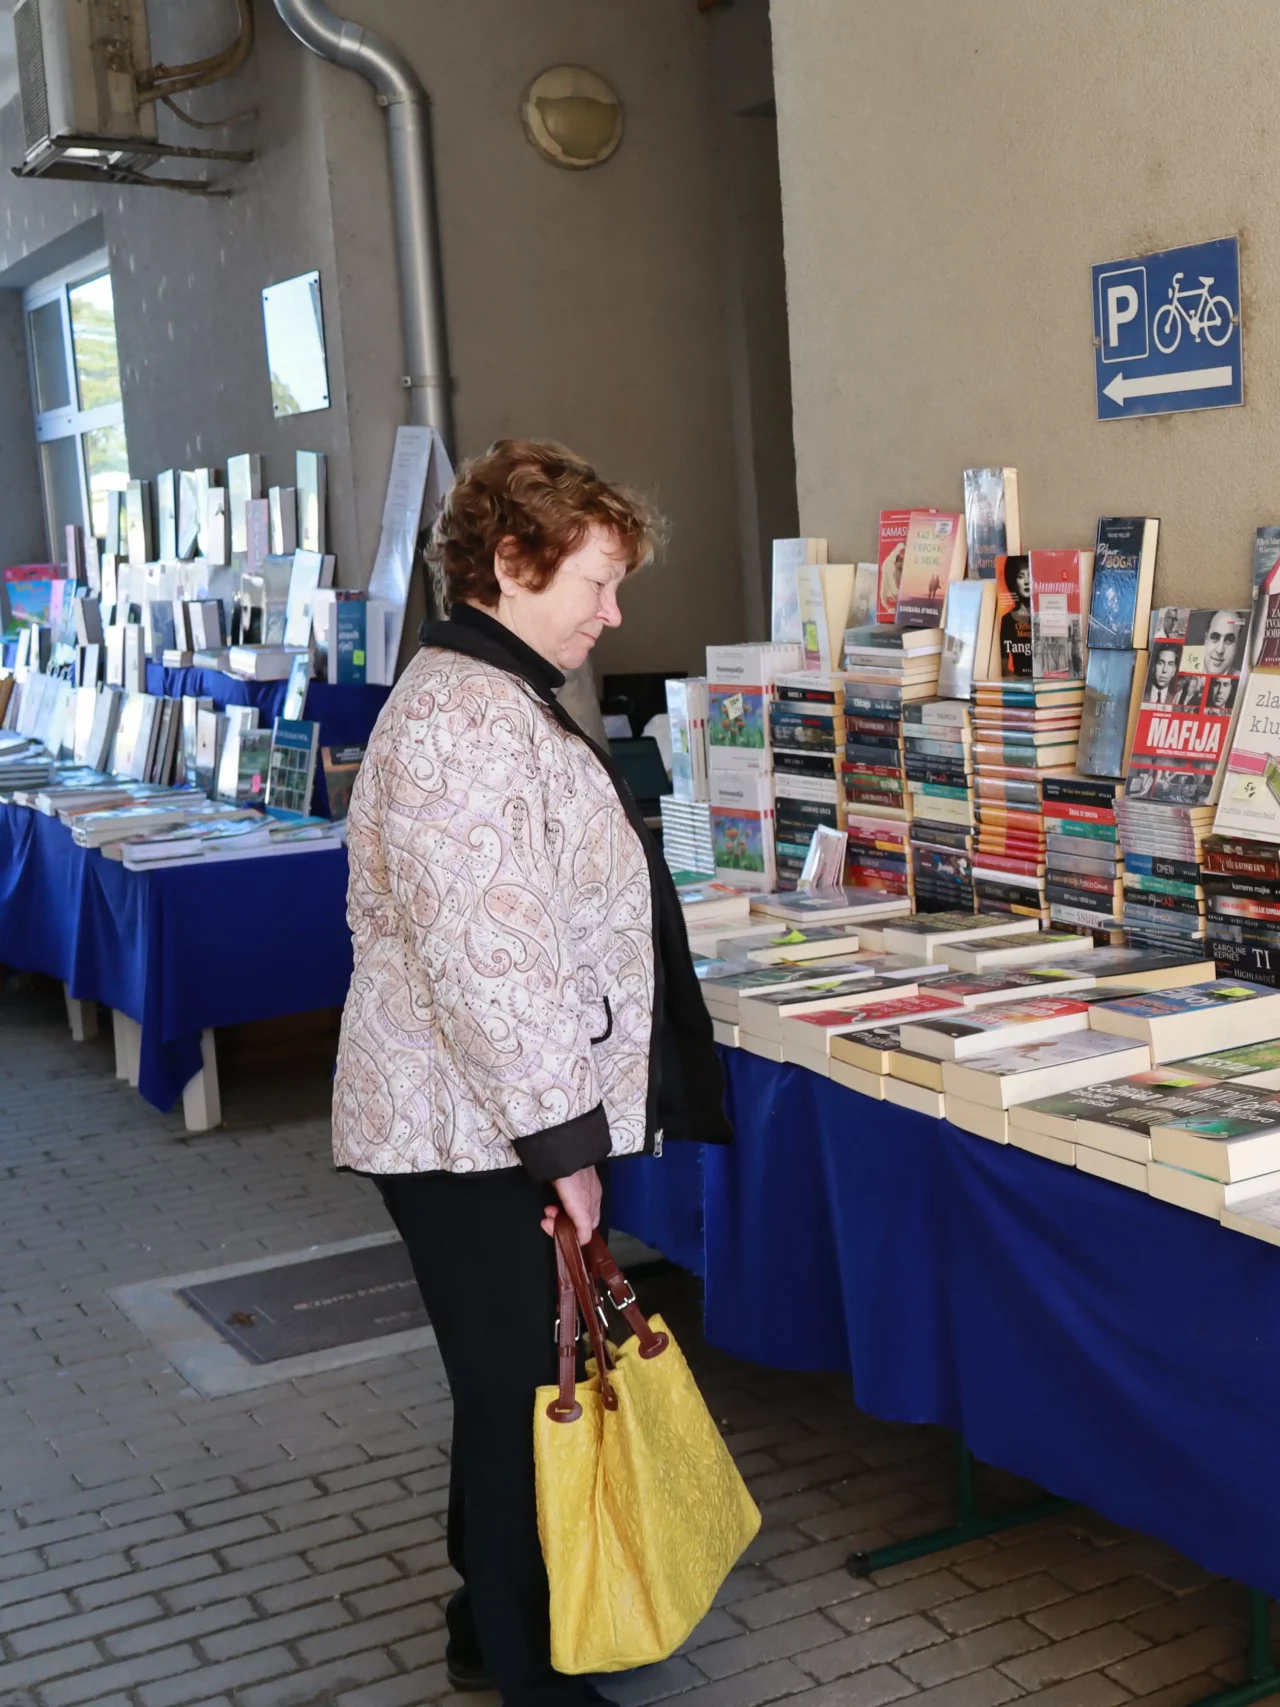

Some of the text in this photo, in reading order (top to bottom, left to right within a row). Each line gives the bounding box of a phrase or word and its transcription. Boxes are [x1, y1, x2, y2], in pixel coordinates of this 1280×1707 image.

[1107, 285, 1138, 347] P
[1106, 555, 1138, 569] BOGAT
[1271, 608, 1280, 618] ZA
[1147, 717, 1222, 753] MAFIJA
[1156, 863, 1175, 876] CIMERI
[1213, 943, 1271, 970] CAROLINE TI
[1213, 951, 1240, 962] KEPNES
